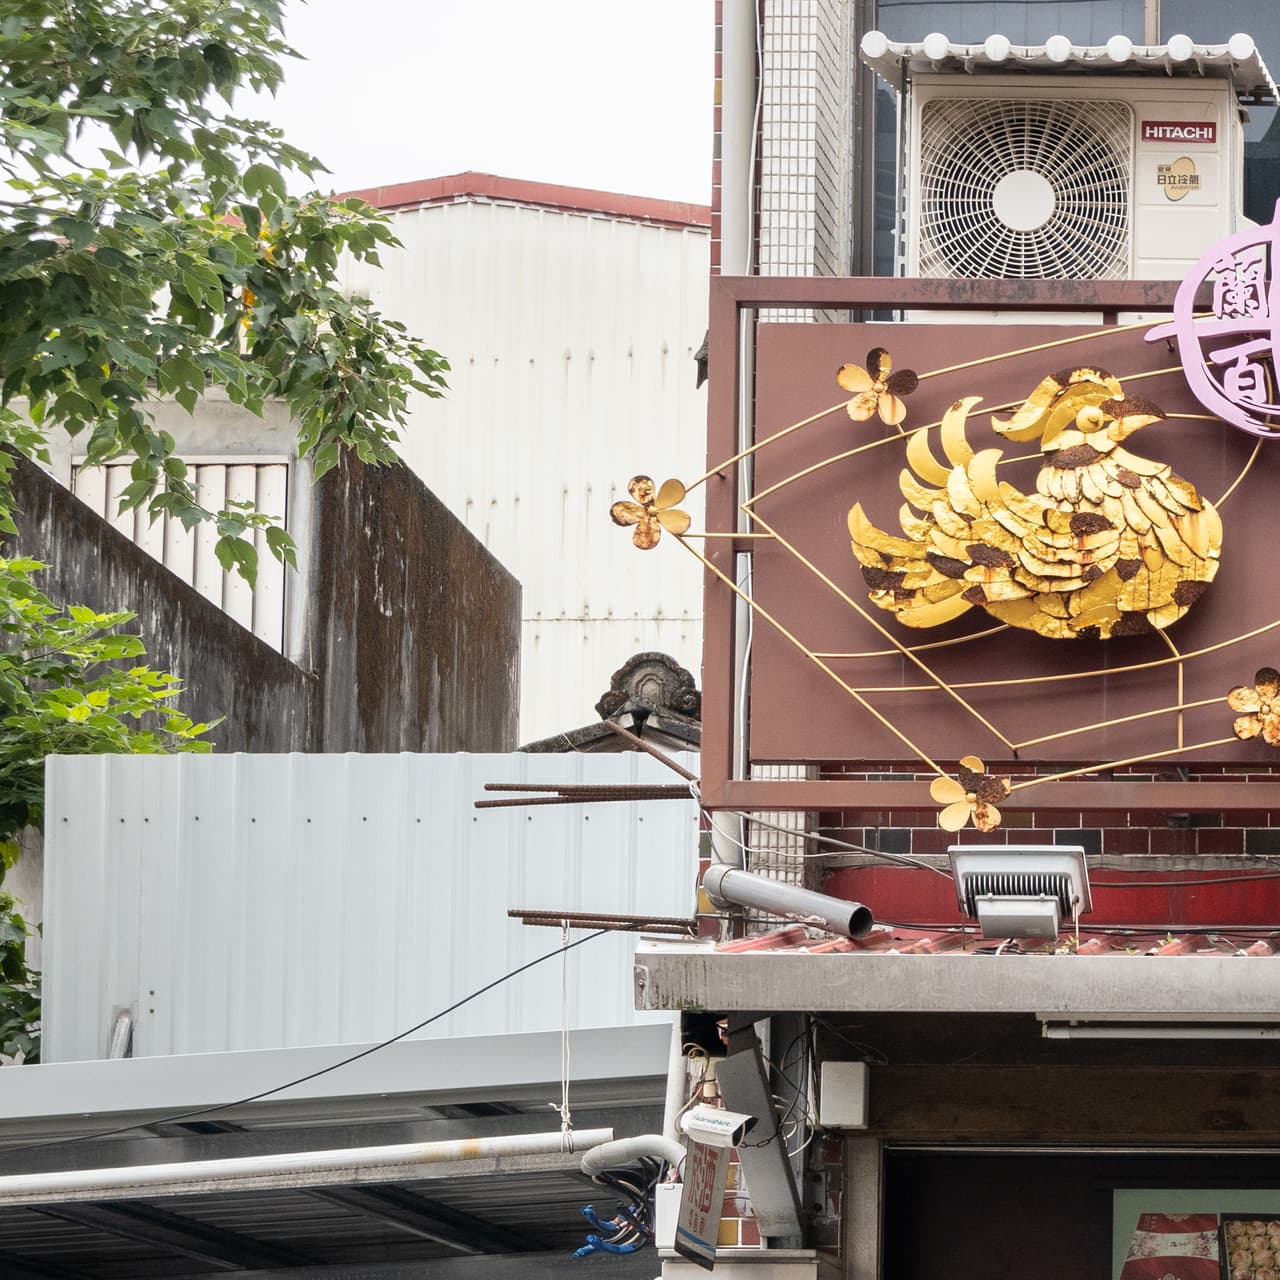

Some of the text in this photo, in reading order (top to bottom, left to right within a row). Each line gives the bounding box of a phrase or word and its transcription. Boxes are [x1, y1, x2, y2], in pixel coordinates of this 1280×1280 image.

[1145, 126, 1213, 139] HITACHI
[1157, 174, 1199, 185] 日立冷氣
